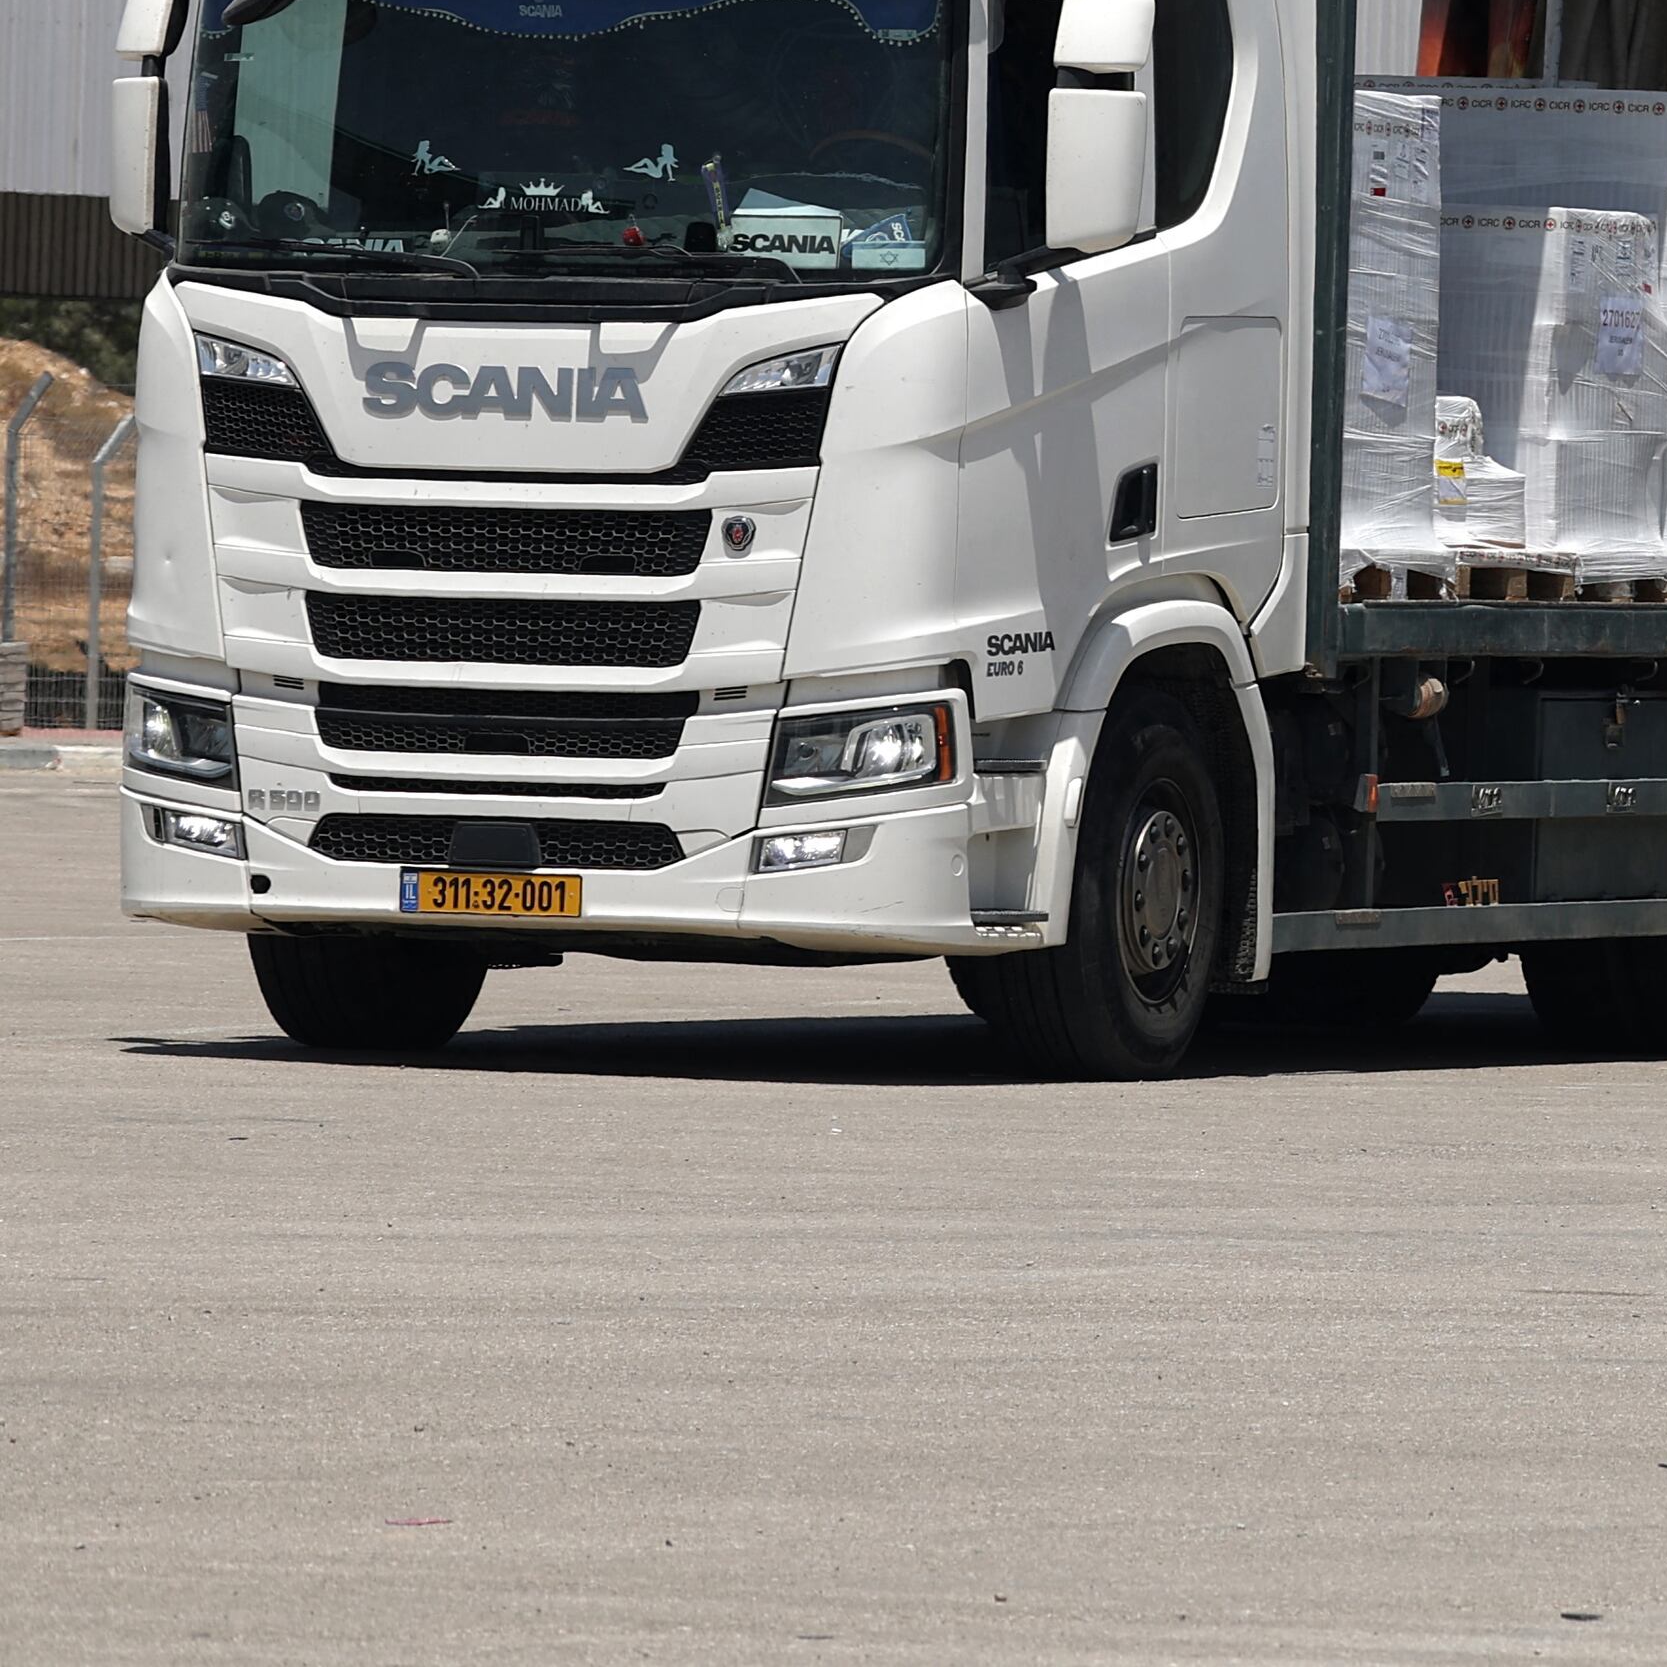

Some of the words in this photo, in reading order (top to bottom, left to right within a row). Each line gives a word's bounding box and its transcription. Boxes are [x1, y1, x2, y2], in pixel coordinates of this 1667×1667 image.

[518, 4, 562, 18] SCANIA
[1472, 99, 1492, 108] CICR
[1511, 100, 1531, 109] ICRC
[1549, 101, 1570, 110] CICR
[1589, 102, 1609, 111] ICRC
[1628, 104, 1649, 113] CICR
[510, 196, 581, 211] MOHMAD
[1478, 218, 1500, 227] ICRC
[1519, 219, 1541, 229] CICR
[729, 233, 836, 254] SCANIA
[362, 362, 649, 424] SCANIA
[987, 631, 1055, 656] SCANIA
[986, 661, 1015, 677] EURO
[1017, 660, 1024, 675] 6
[405, 884, 417, 900] IL
